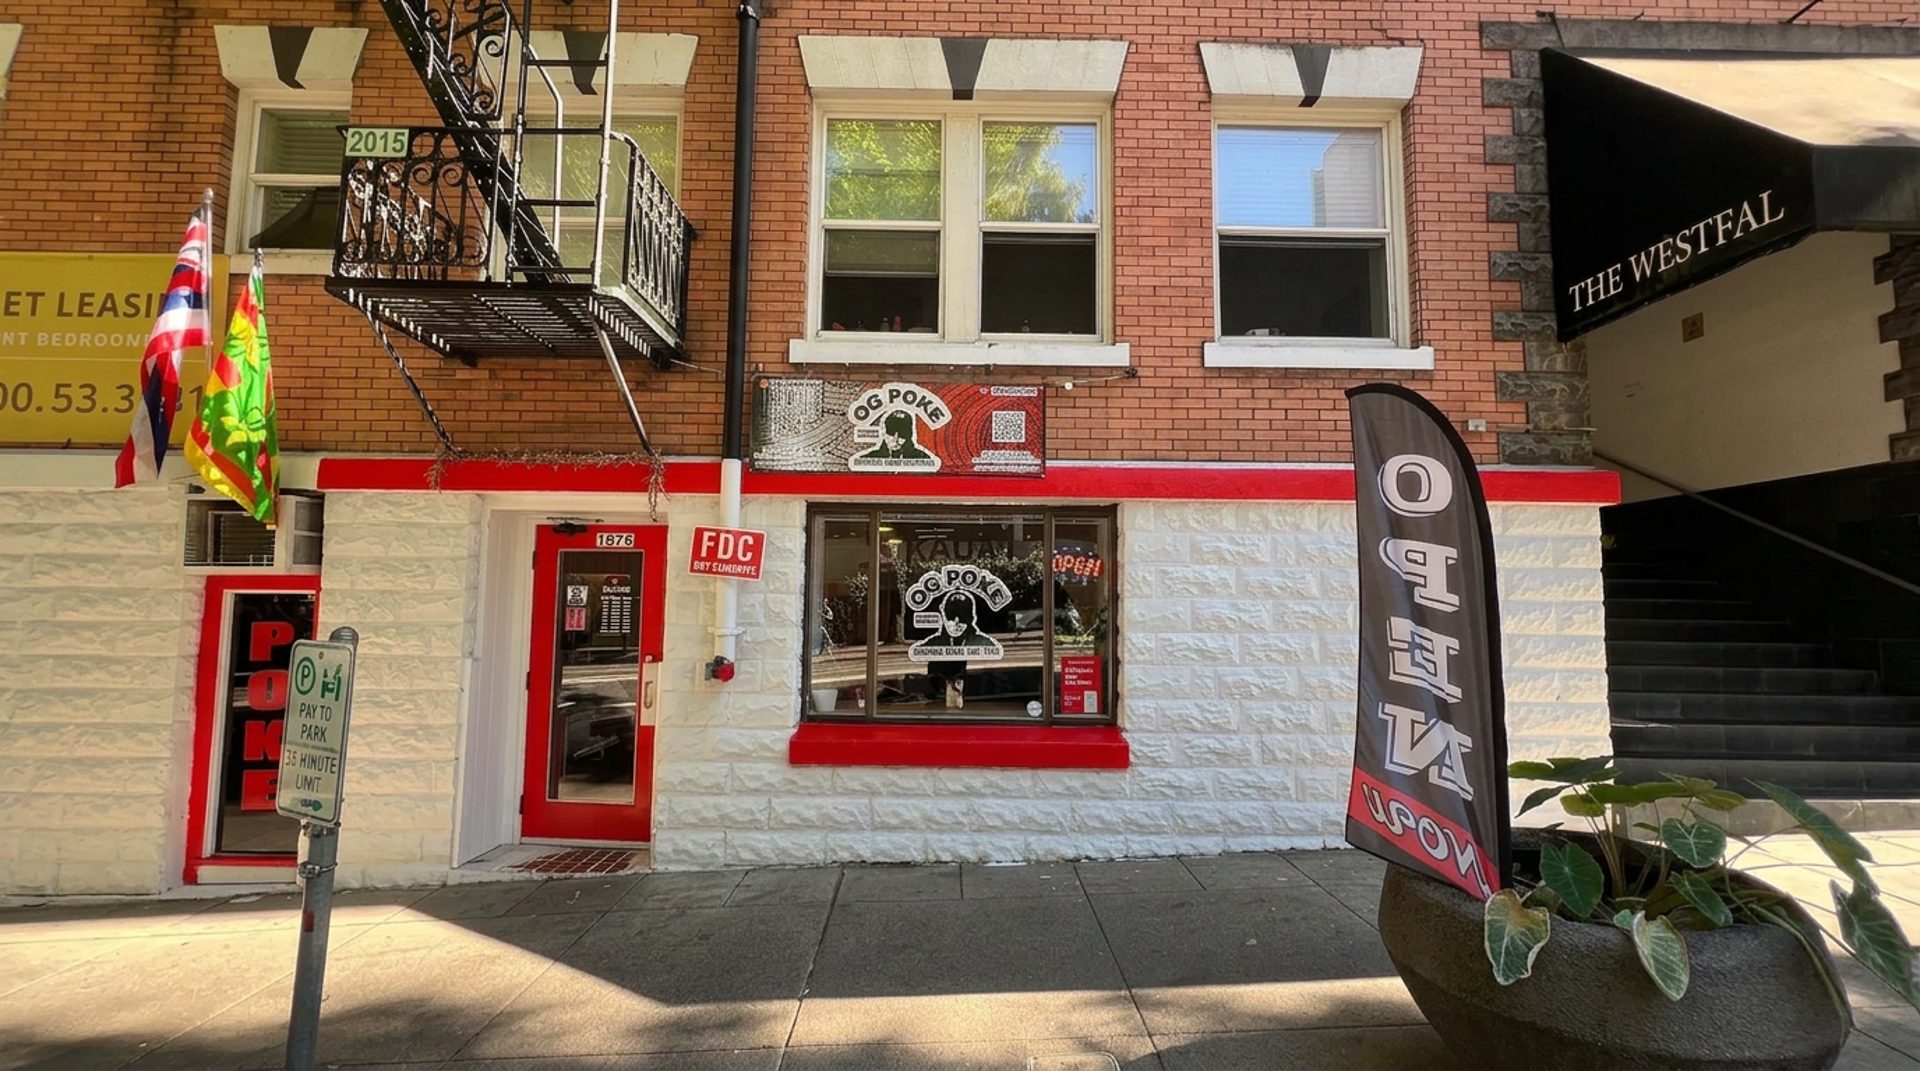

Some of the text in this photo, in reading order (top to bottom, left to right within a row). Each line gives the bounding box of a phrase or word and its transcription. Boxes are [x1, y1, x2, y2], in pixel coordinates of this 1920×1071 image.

[349, 130, 405, 153] 2015
[1568, 189, 1785, 312] THE WESTFAL
[854, 389, 945, 424] OG POKE
[598, 534, 633, 546] 1876
[701, 531, 754, 562] FDC
[241, 621, 295, 811] POKE
[300, 702, 332, 721] PAY TO
[300, 723, 327, 743] PARK
